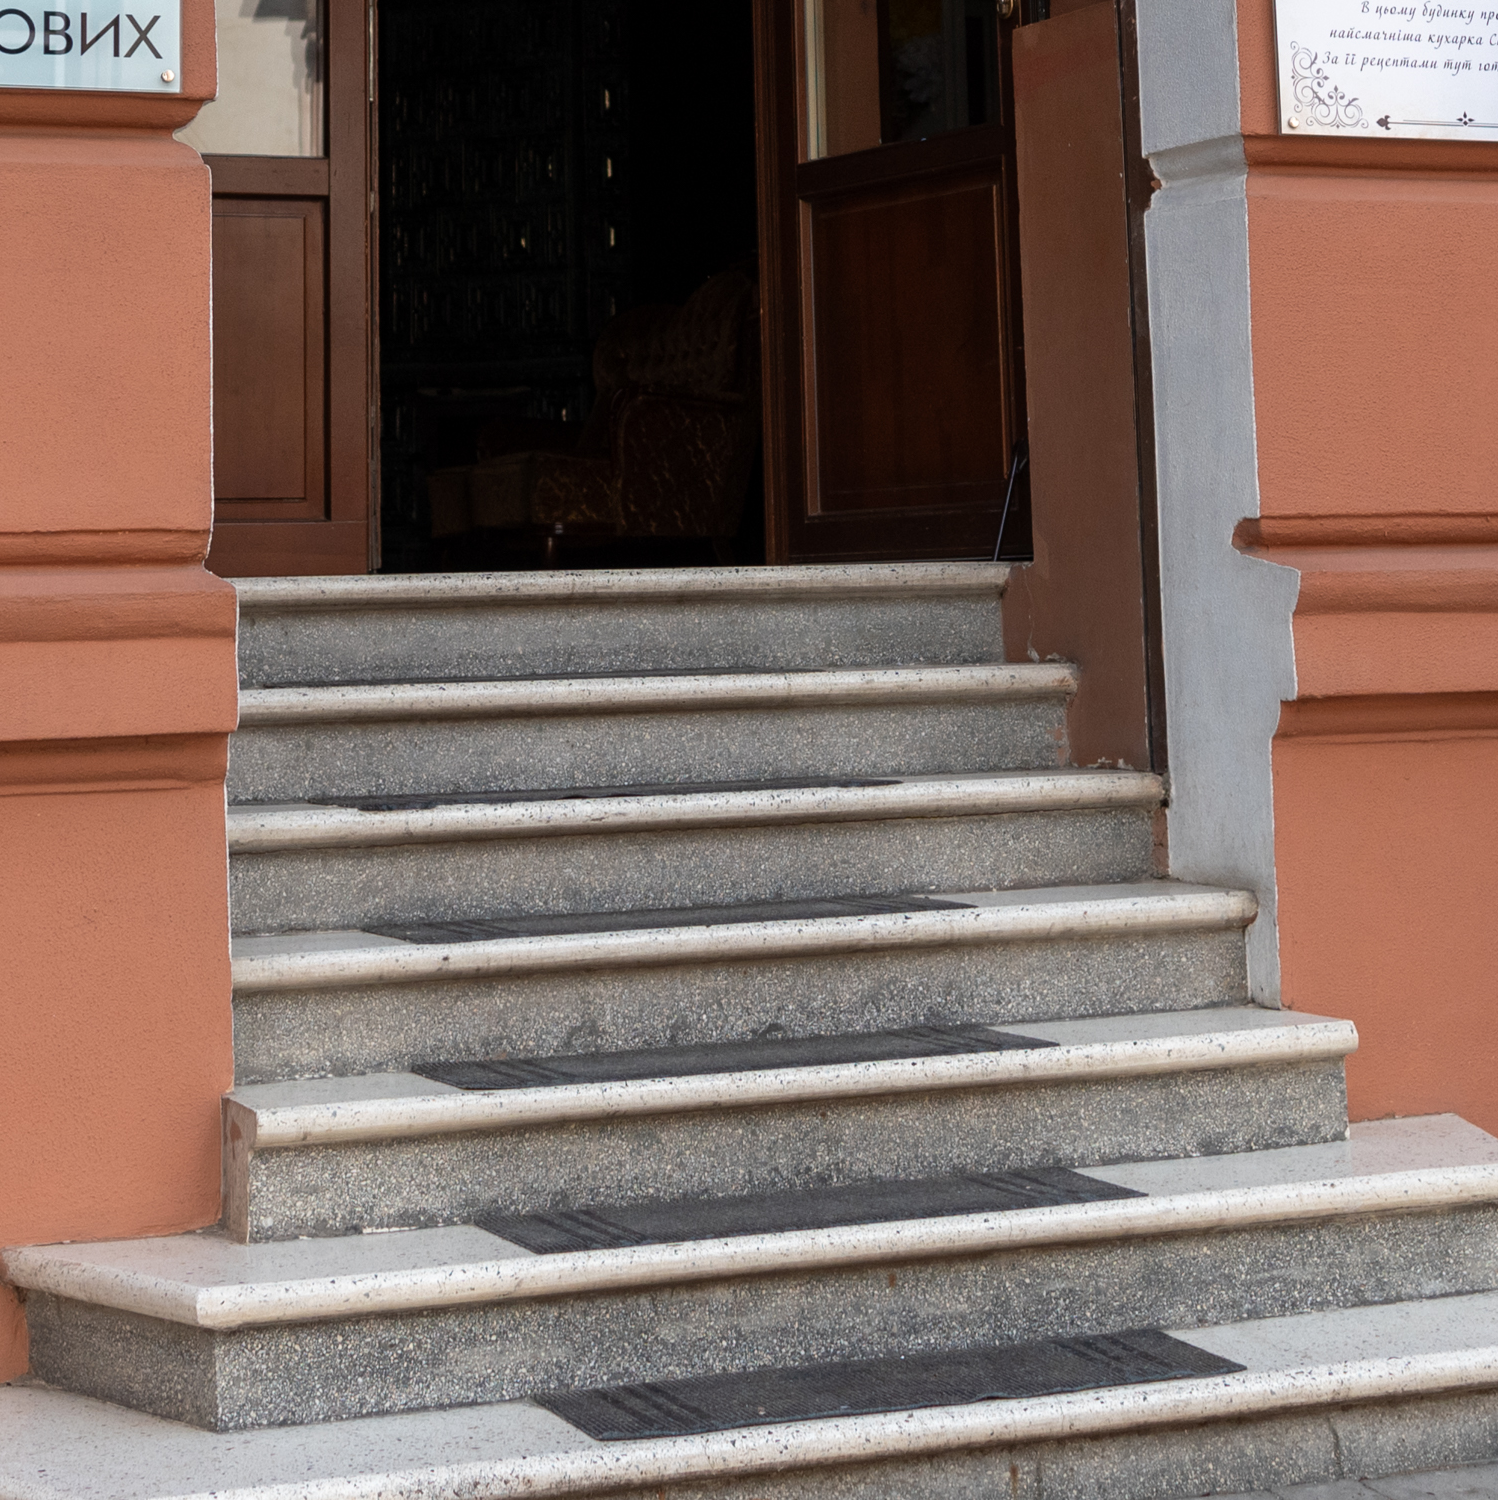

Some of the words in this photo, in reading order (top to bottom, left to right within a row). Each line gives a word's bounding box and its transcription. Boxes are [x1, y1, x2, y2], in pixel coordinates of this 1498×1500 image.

[1361, 1, 1370, 14] В
[1375, 5, 1417, 22] цьому
[1422, 0, 1475, 25] будинку
[1329, 27, 1422, 43] найсмачніша
[1427, 33, 1483, 50] кухарка
[1322, 51, 1339, 65] За
[1345, 53, 1357, 65] її
[1360, 56, 1438, 72] рецептами
[1443, 59, 1472, 77] тут
